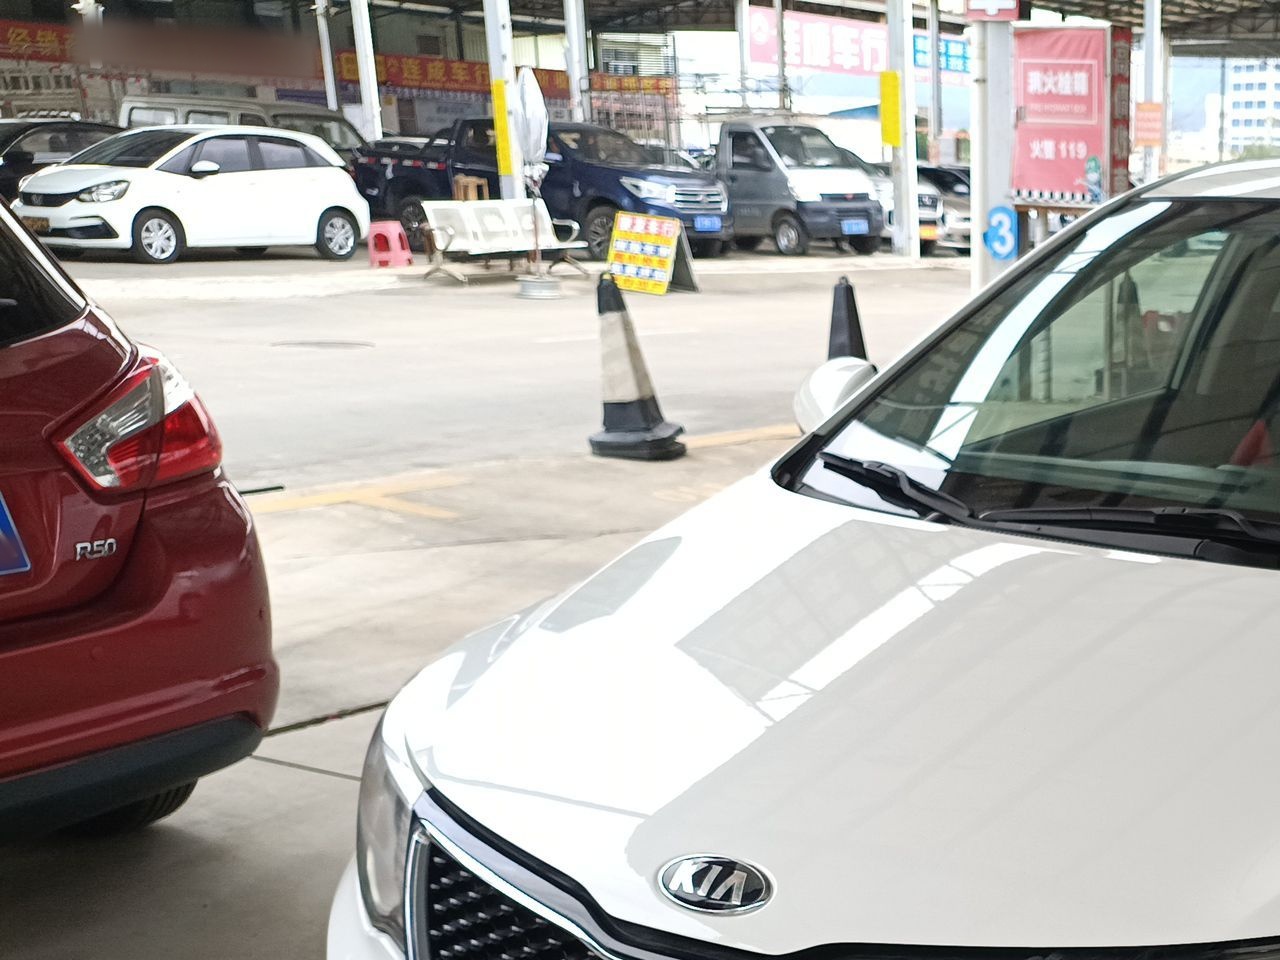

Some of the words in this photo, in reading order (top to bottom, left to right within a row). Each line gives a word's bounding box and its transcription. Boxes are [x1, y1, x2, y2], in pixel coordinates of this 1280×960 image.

[1059, 141, 1087, 159] 119
[991, 213, 1015, 256] 3
[75, 538, 117, 561] R50
[669, 860, 748, 905] KIA
